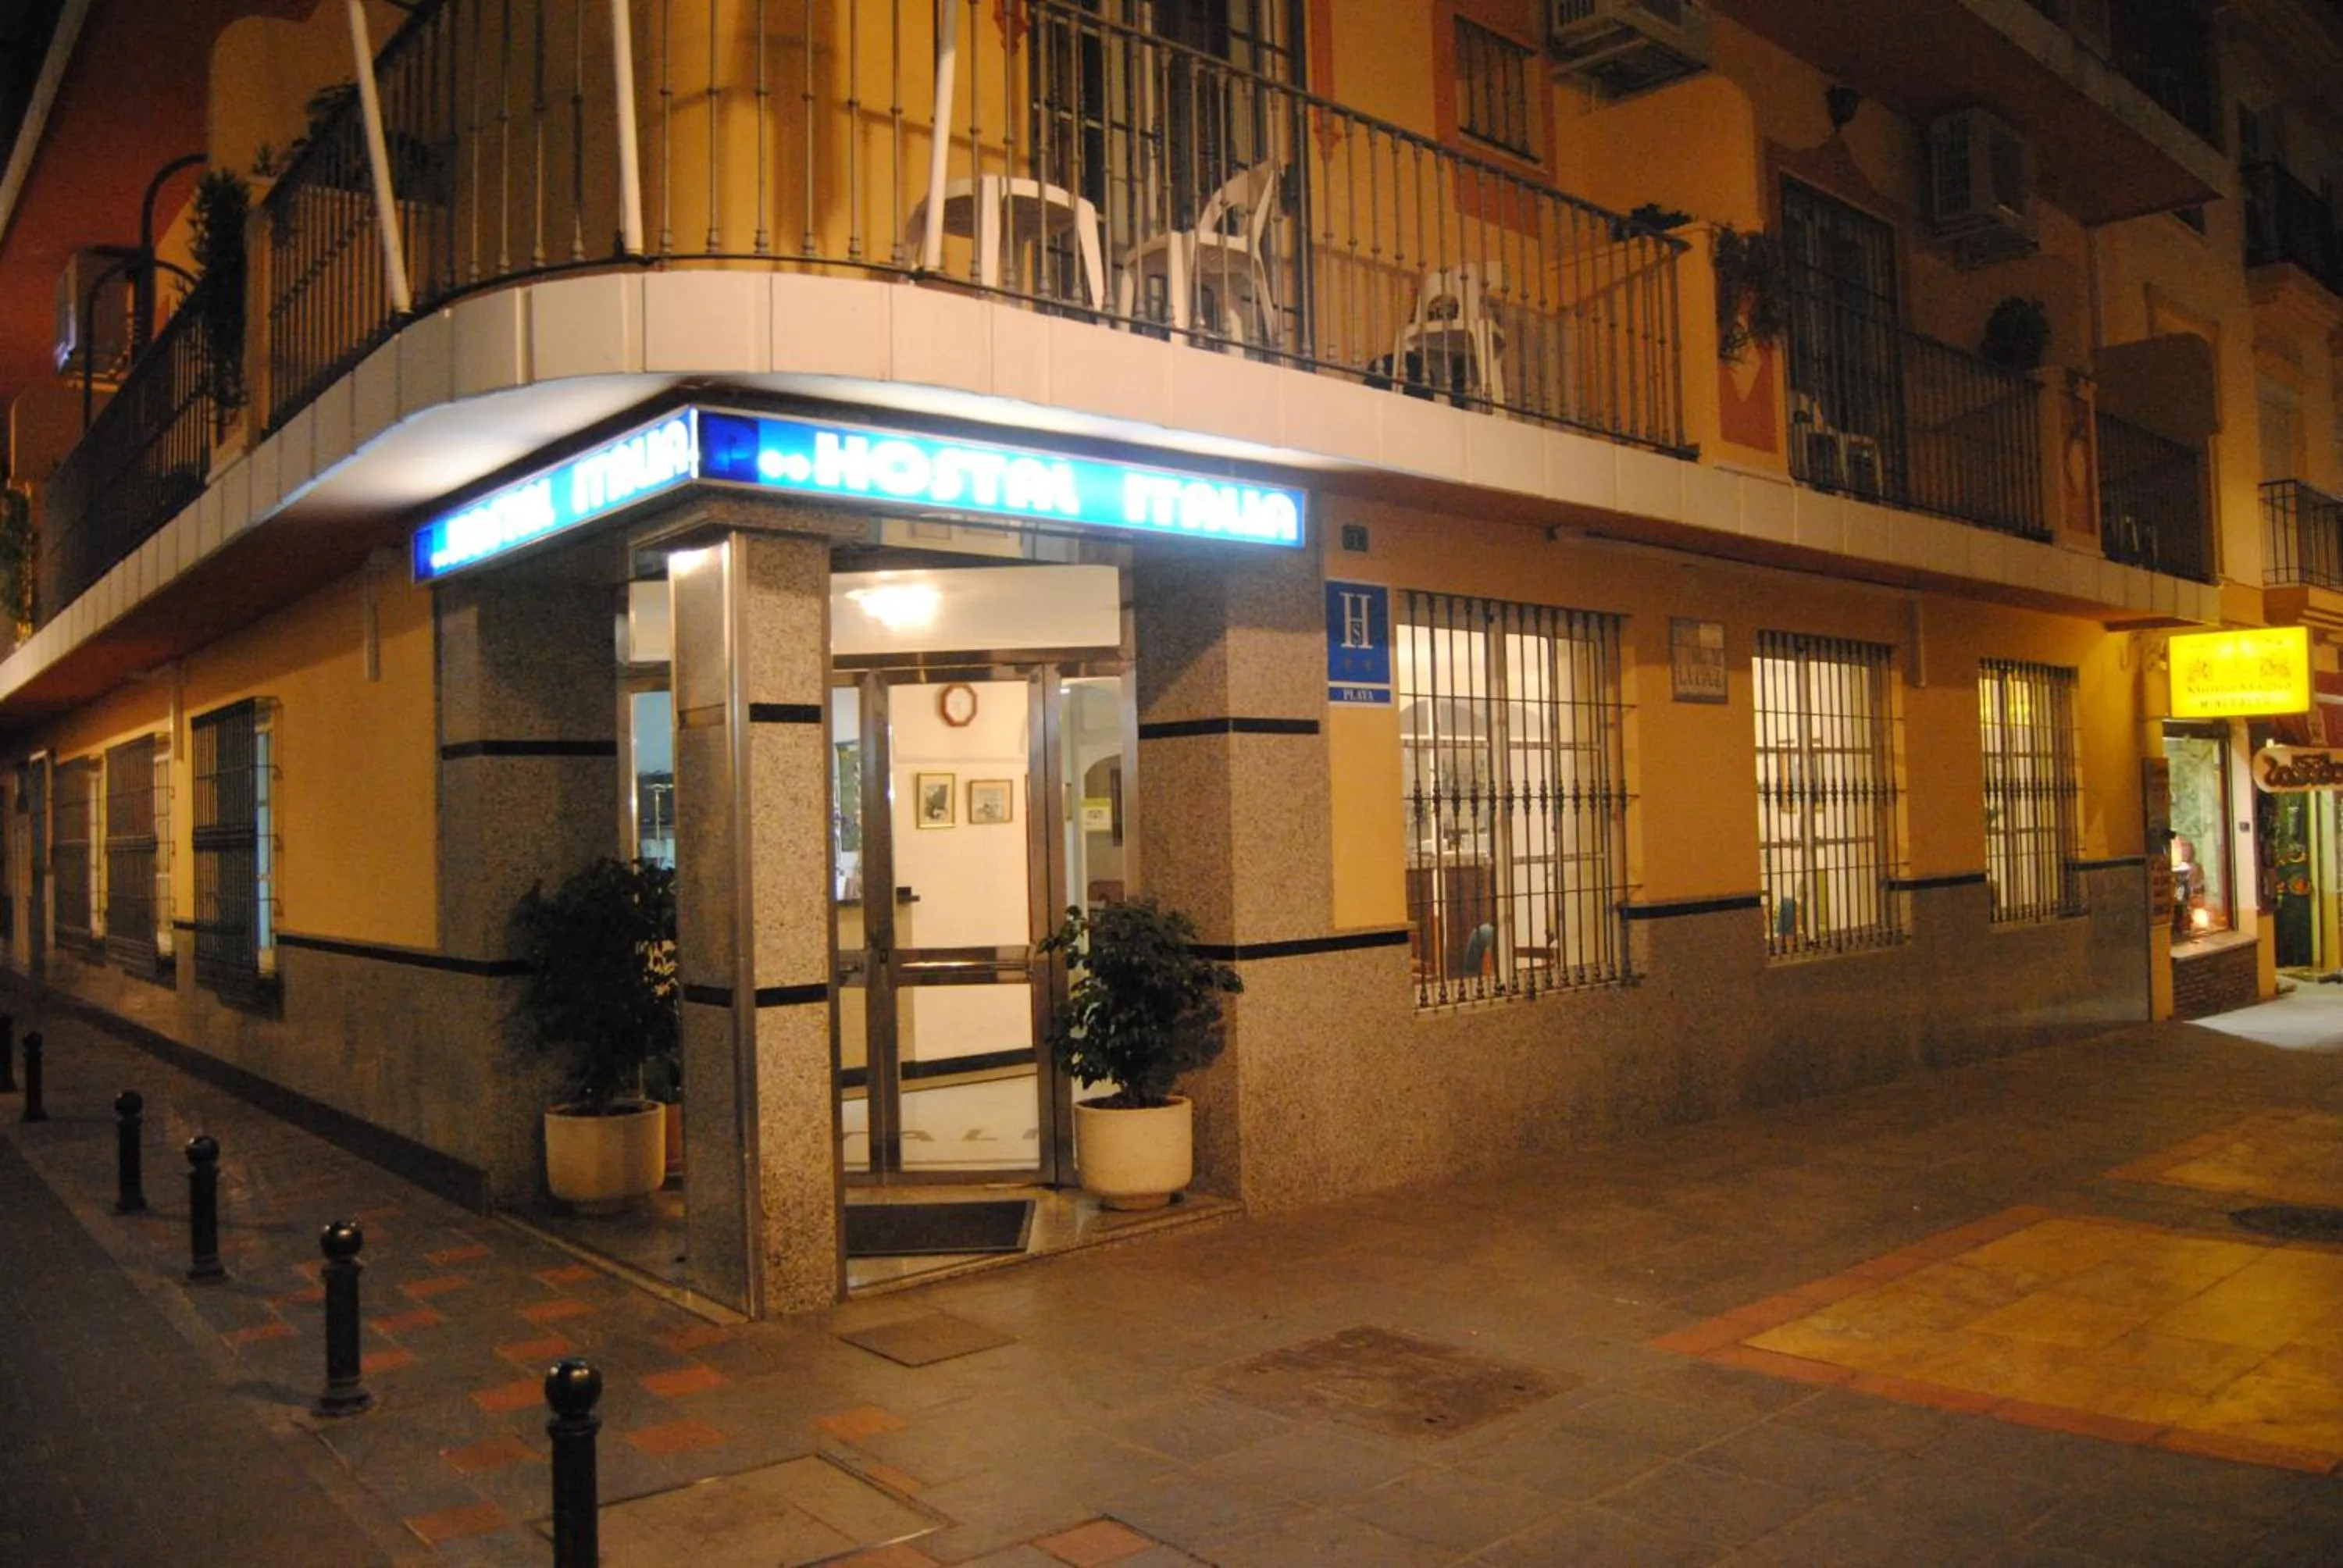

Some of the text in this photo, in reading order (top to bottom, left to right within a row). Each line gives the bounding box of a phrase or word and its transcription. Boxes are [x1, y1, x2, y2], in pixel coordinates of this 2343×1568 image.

[813, 433, 1297, 540] HOSTAL ITALIA
[1342, 688, 1375, 701] PLAYA
